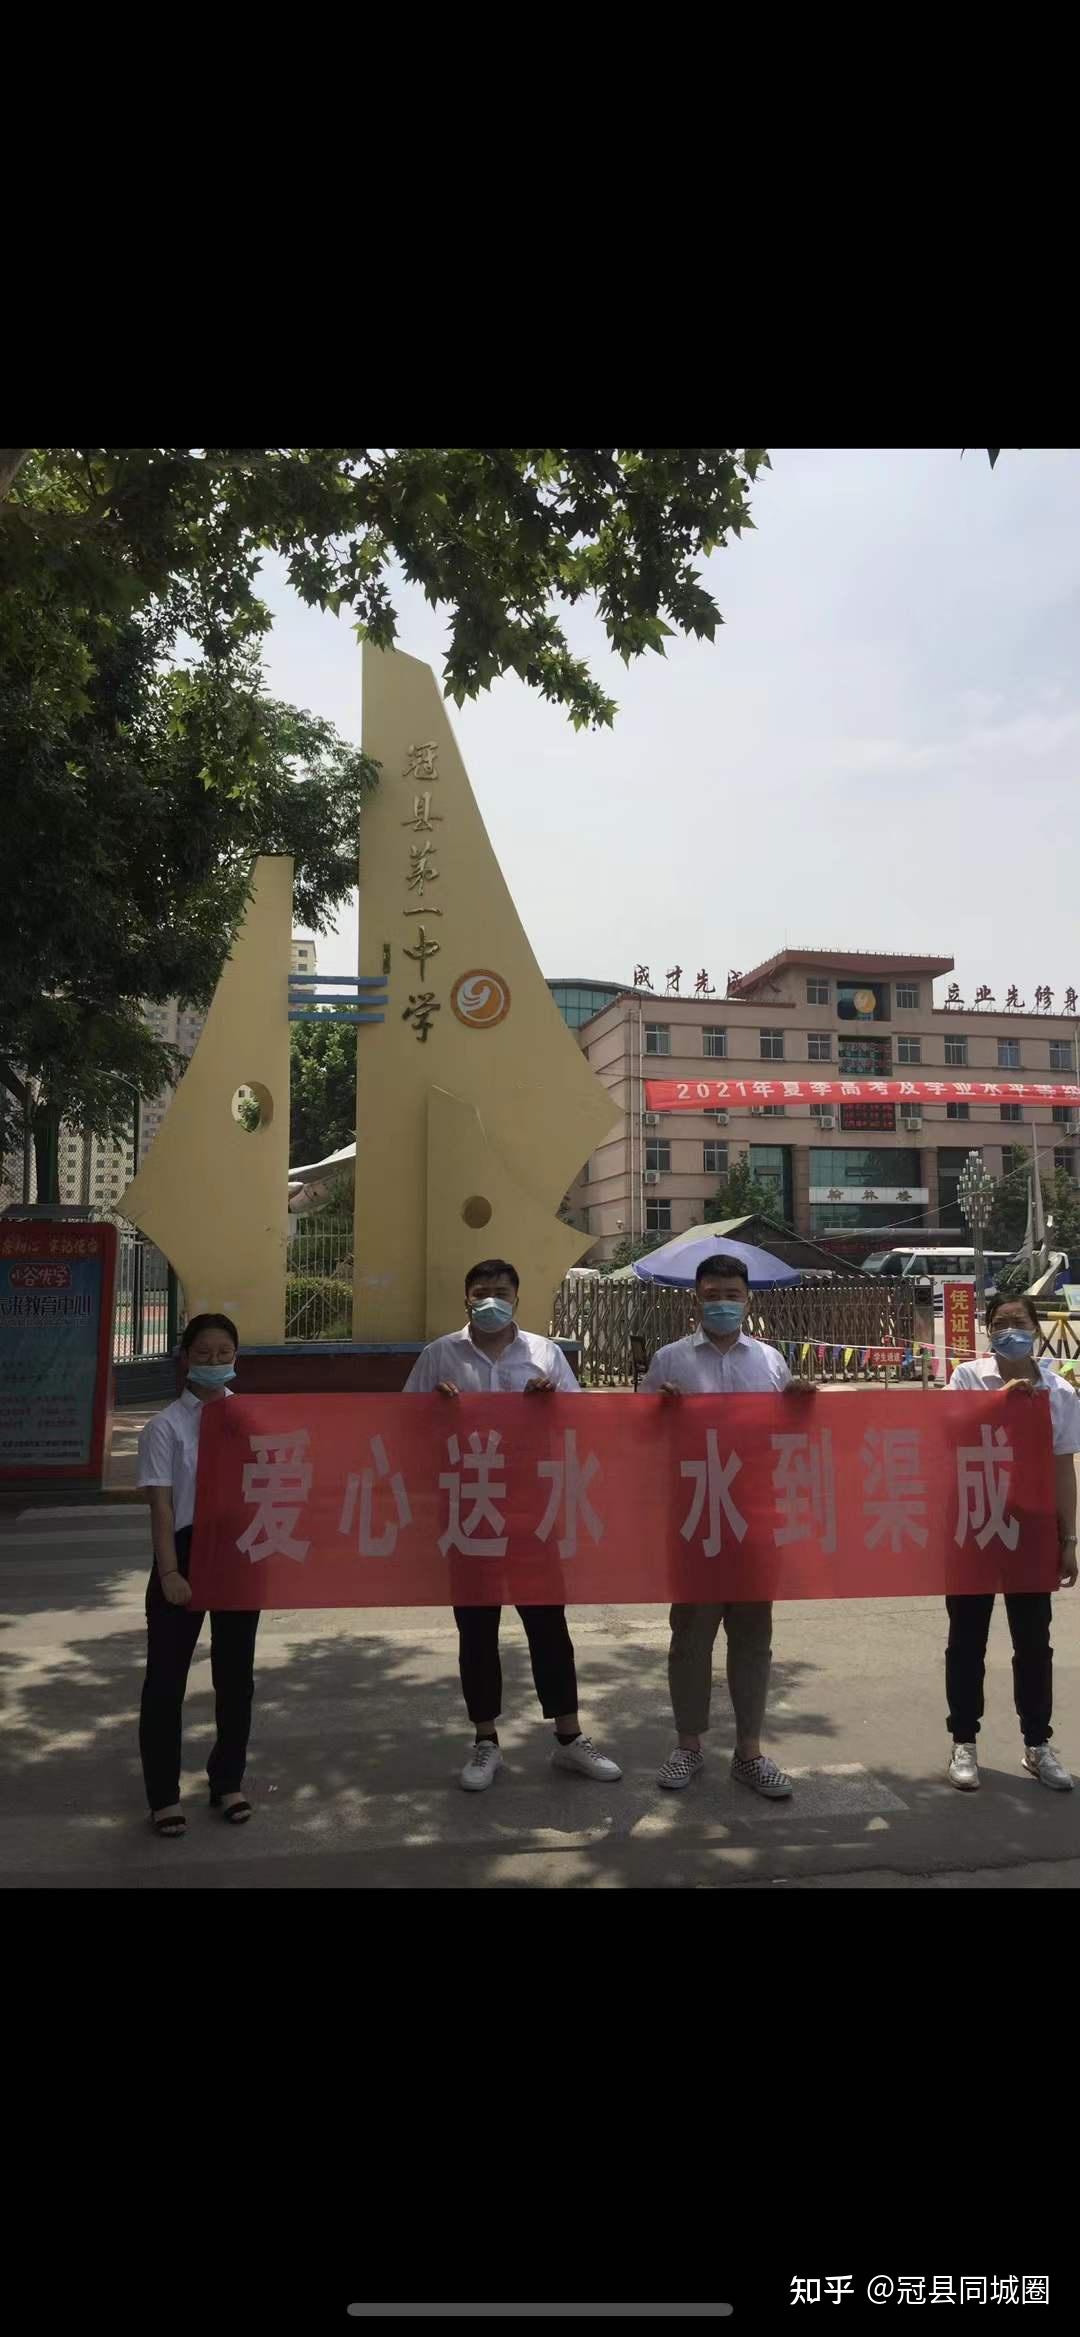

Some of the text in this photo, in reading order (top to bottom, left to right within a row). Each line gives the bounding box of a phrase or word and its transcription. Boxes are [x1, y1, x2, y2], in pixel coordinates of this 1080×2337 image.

[402, 741, 443, 1043] 冠县第一中学
[944, 983, 1078, 1012] 立业先修身
[236, 1424, 1021, 1563] 爱心送水 水到渠成
